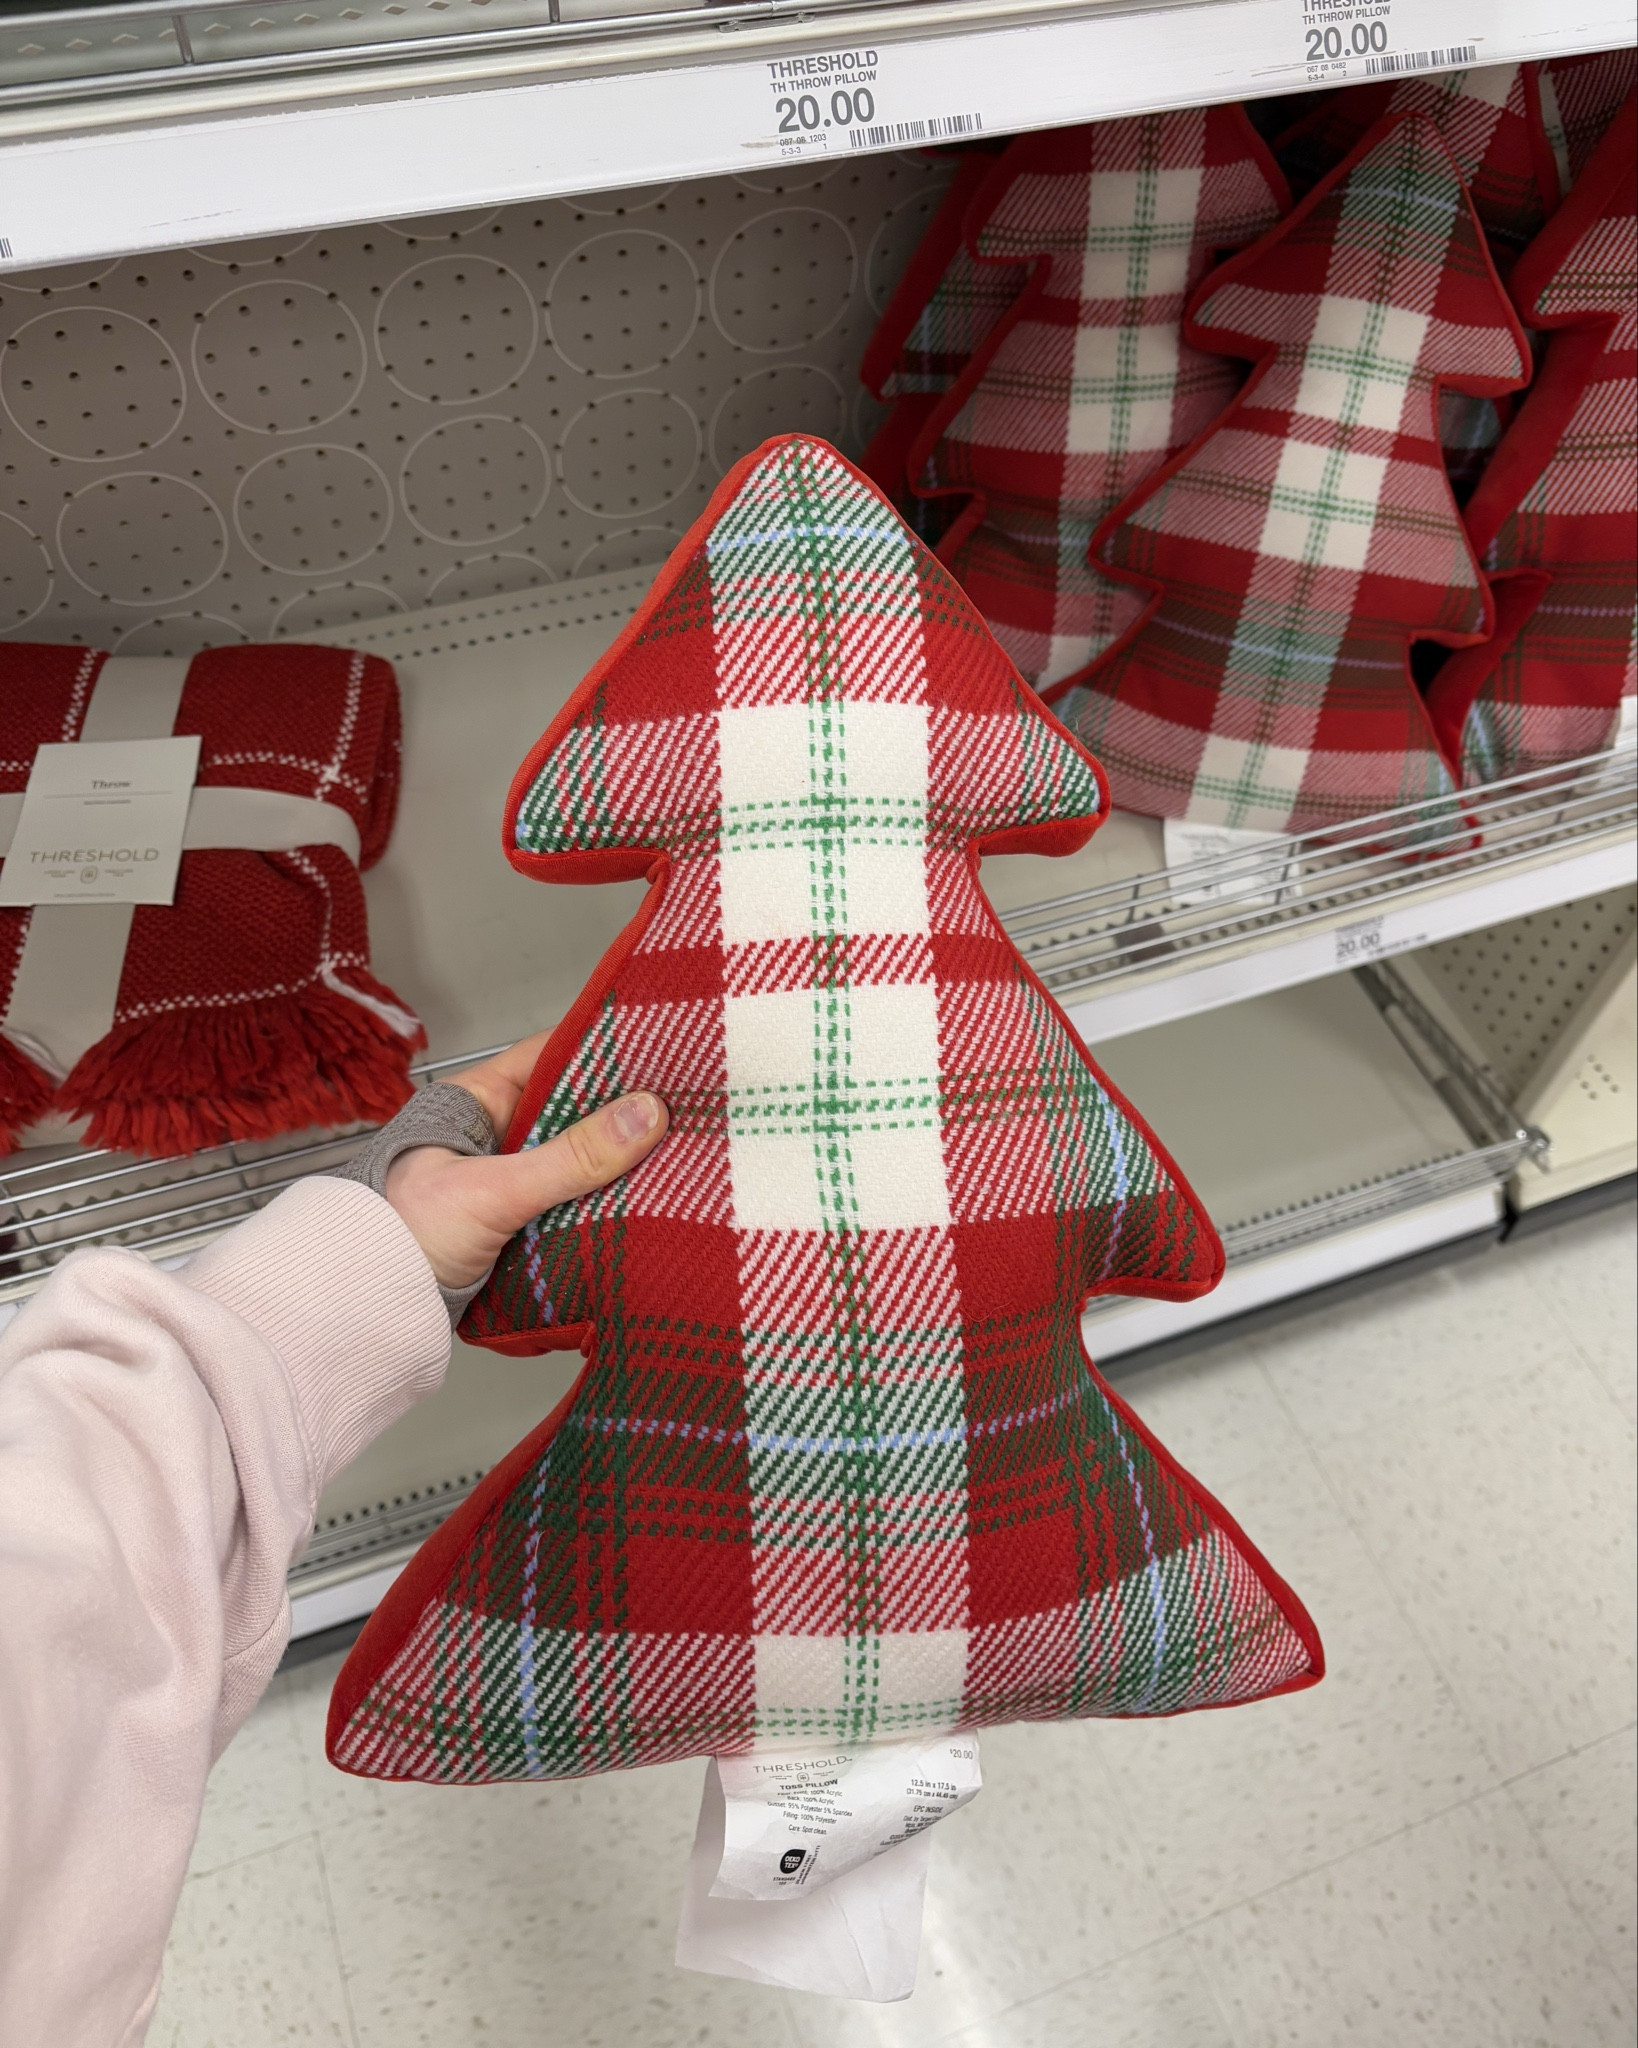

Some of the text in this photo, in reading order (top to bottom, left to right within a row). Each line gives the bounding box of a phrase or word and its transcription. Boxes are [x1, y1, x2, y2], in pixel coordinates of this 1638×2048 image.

[1302, 5, 1391, 25] TH THROW PILLOW
[1305, 21, 1388, 61] 20.00
[767, 50, 878, 79] THRESHOLD
[770, 70, 877, 93] TH THROW PILLOW
[776, 87, 875, 133] 20.00
[809, 133, 827, 143] 1203
[781, 146, 801, 156] 5-3-3
[30, 848, 159, 863] THRESHOLD
[949, 1748, 974, 1760] $20.00
[805, 1779, 838, 1788] PILLOW
[911, 1779, 924, 1788] 12.5
[938, 1782, 950, 1791] 17.5
[826, 1789, 843, 1798] Acrylic
[803, 1796, 818, 1804] 100%
[819, 1797, 835, 1806] Acrylic
[800, 1804, 823, 1813] Polyester
[832, 1808, 853, 1817] Spandex
[800, 1812, 814, 1821] 100%
[815, 1814, 838, 1825] Polyester
[802, 1825, 813, 1835] Spot
